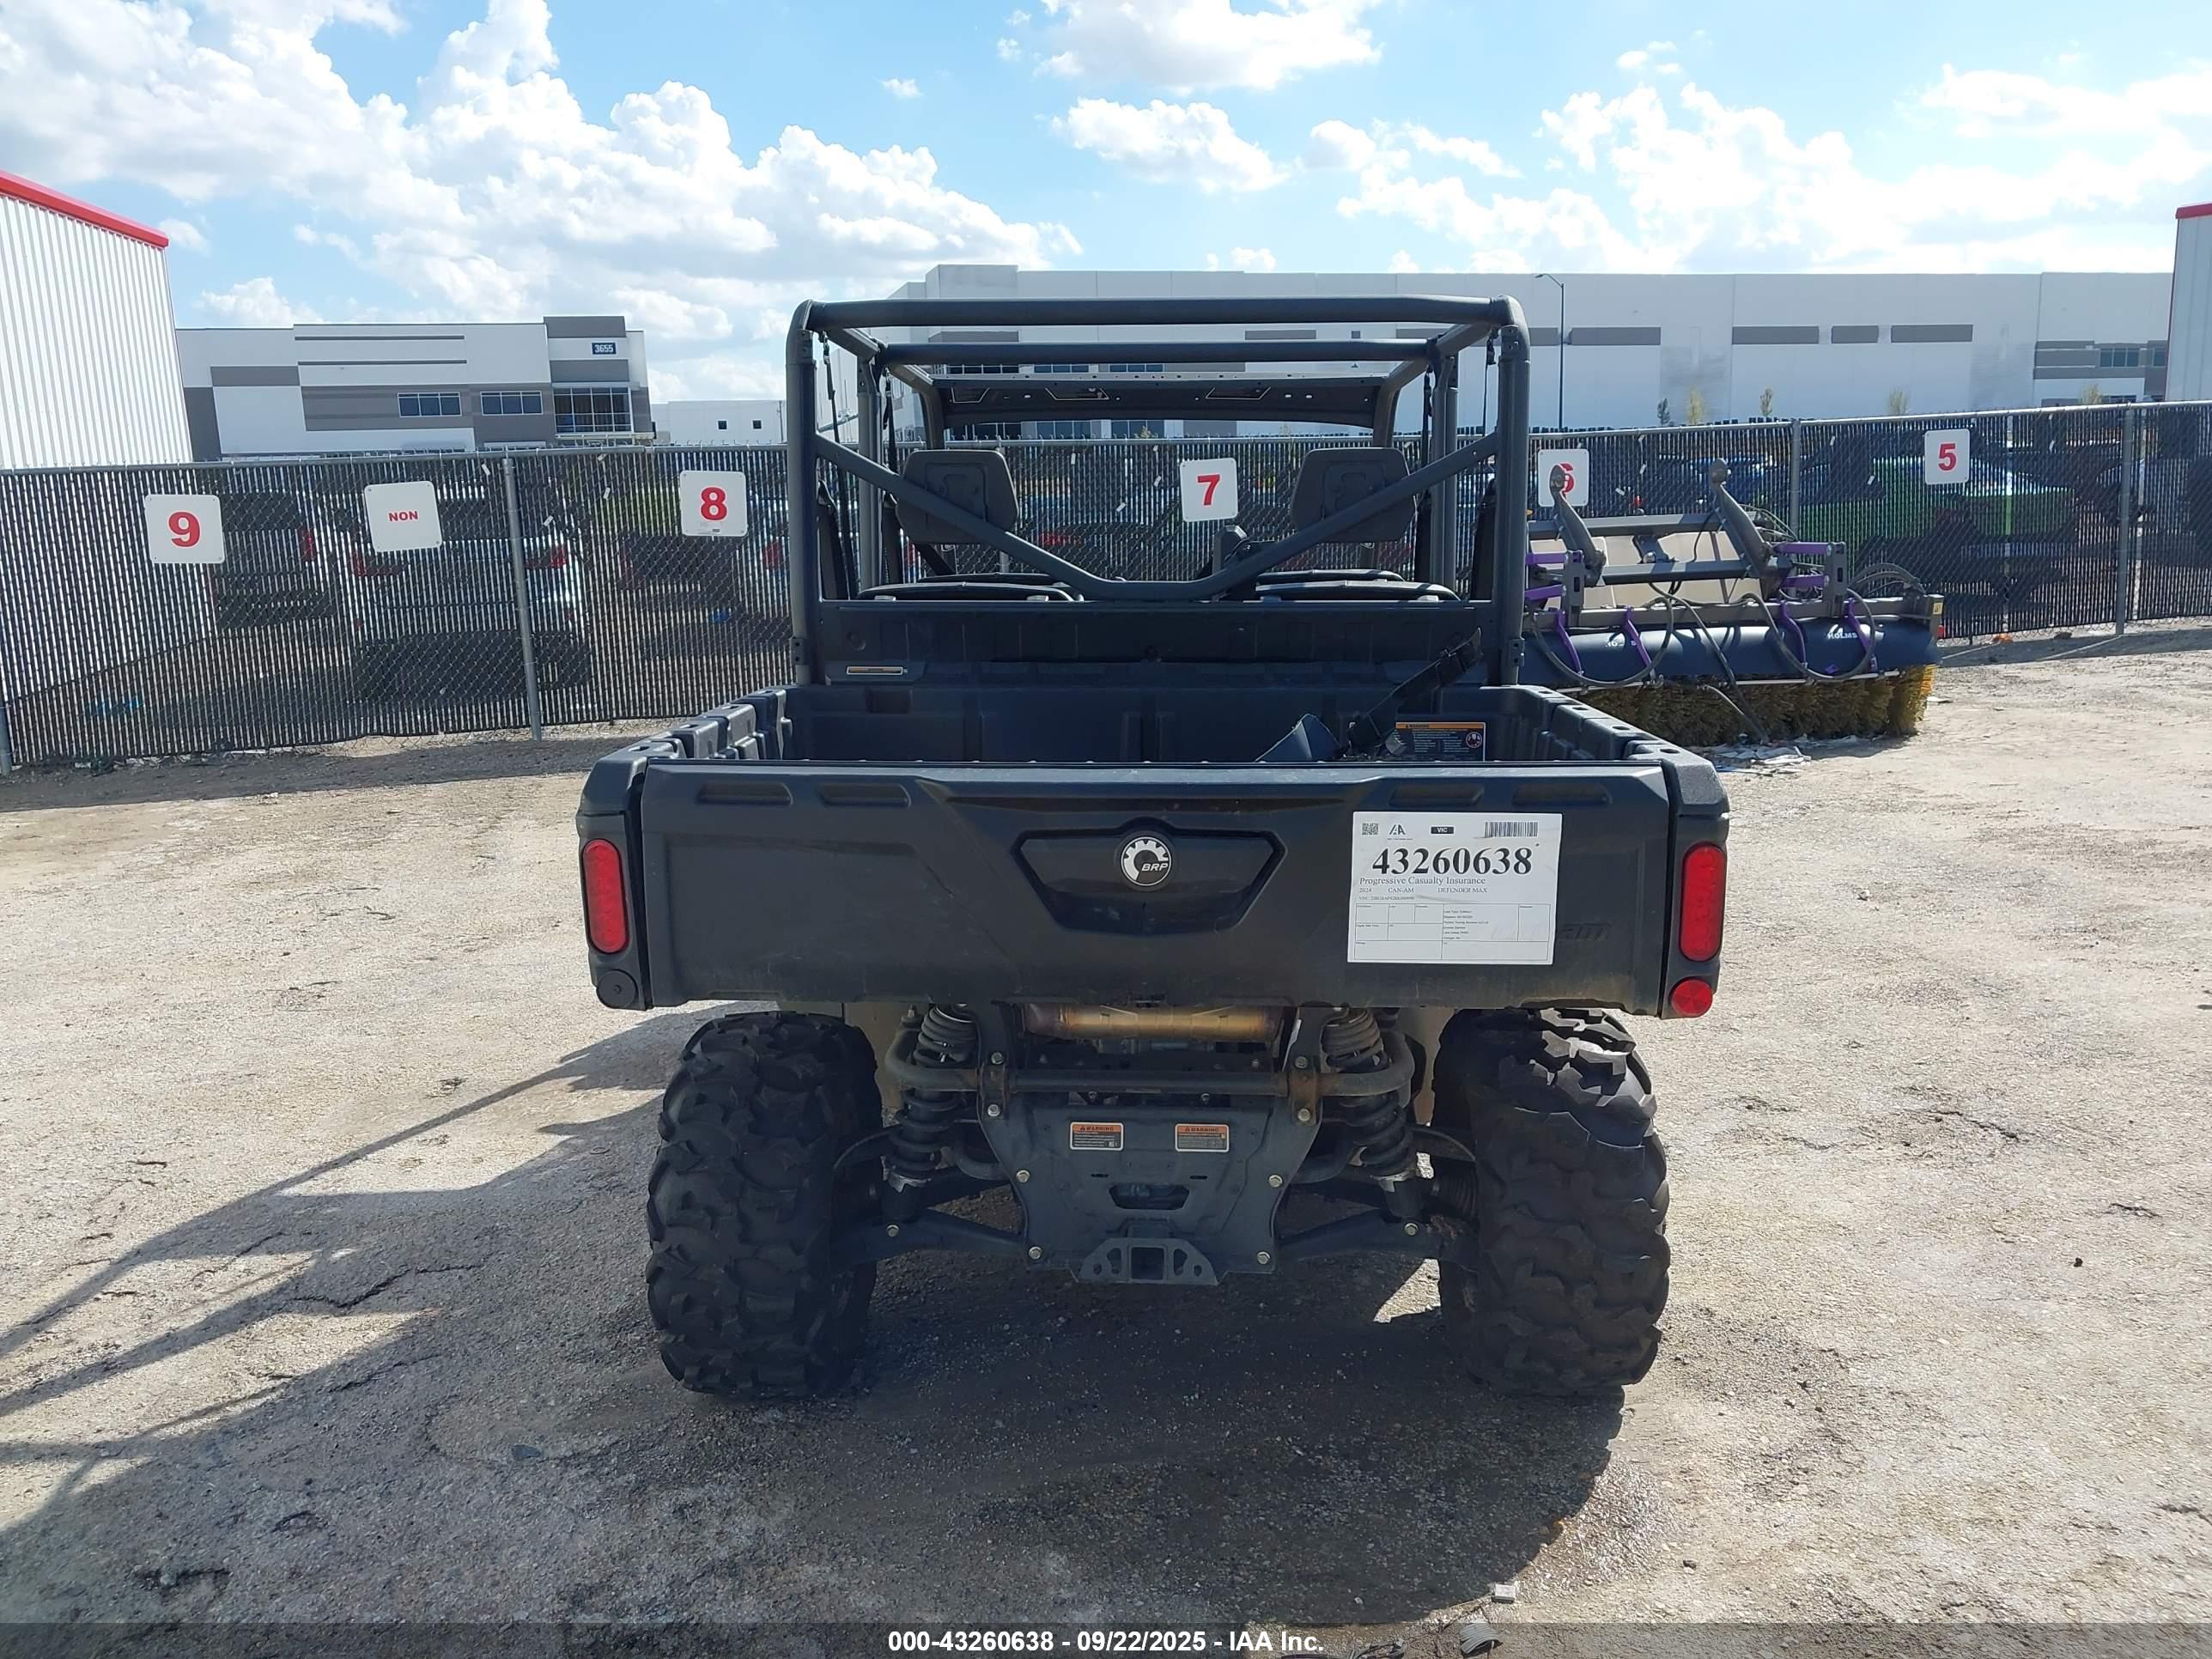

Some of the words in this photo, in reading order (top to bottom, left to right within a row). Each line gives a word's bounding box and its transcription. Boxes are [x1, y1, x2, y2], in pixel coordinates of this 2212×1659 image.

[594, 343, 614, 354] 3655
[1938, 442, 1957, 471] 5
[1197, 473, 1221, 506] 7
[388, 510, 418, 522] NON
[700, 486, 728, 520] 8
[168, 511, 201, 547] 9
[1141, 863, 1169, 872] BRP
[1372, 848, 1532, 874] 43260638
[1359, 877, 1406, 885] Progressive
[1408, 877, 1443, 885] Casualty
